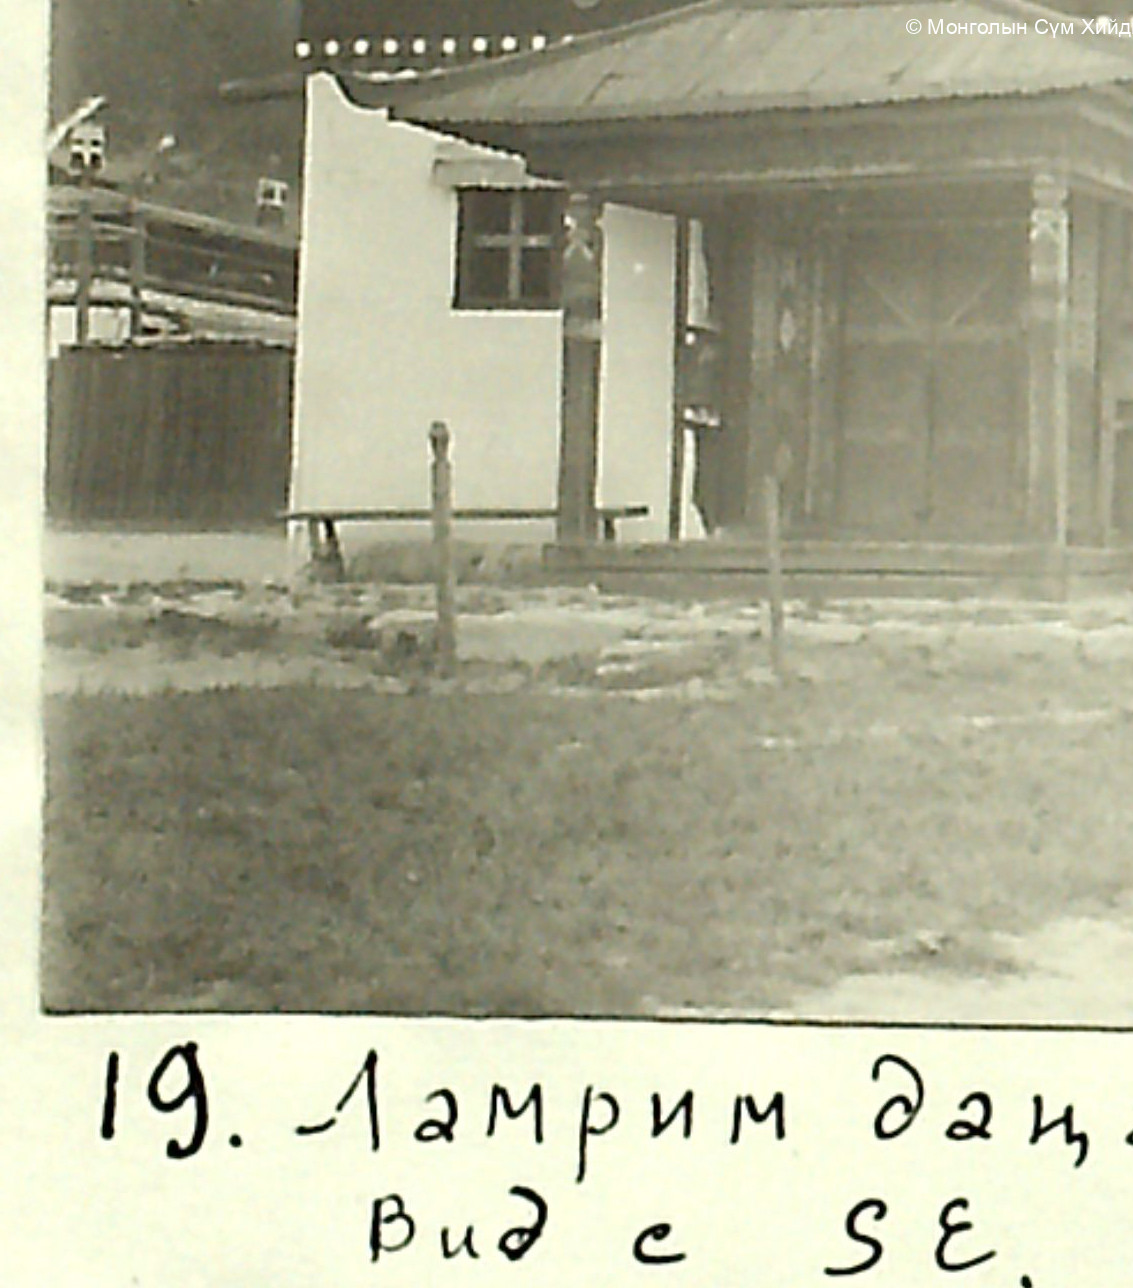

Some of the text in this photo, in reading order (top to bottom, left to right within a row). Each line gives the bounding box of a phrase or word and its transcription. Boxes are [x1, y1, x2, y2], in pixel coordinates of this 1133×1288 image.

[100, 1040, 243, 1160] 19.
[295, 1048, 786, 1184] Ламрим
[369, 1185, 548, 1263] Вид
